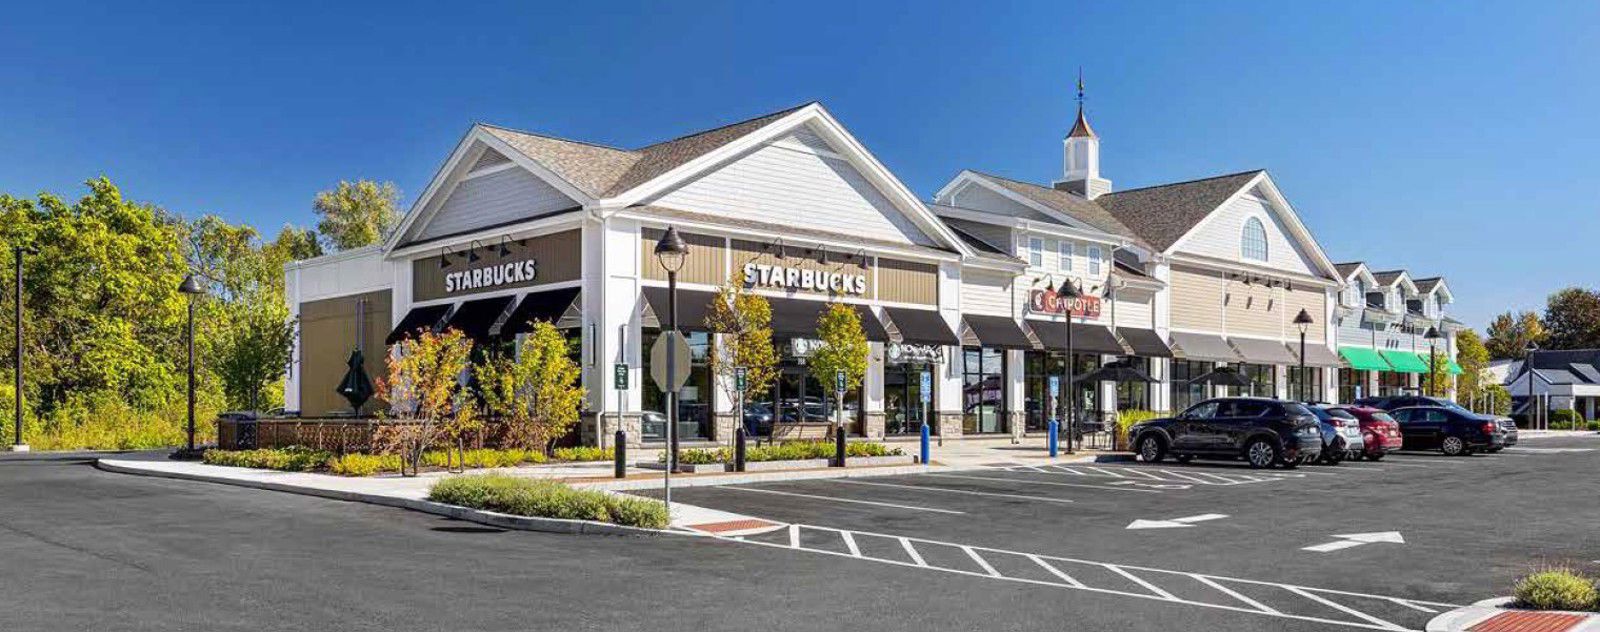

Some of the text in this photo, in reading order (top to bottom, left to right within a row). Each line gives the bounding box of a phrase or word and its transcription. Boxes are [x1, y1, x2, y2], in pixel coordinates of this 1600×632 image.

[446, 260, 535, 292] STARBUCKS
[744, 262, 866, 294] STARBUCKS
[1048, 295, 1099, 312] CHIPOTLE
